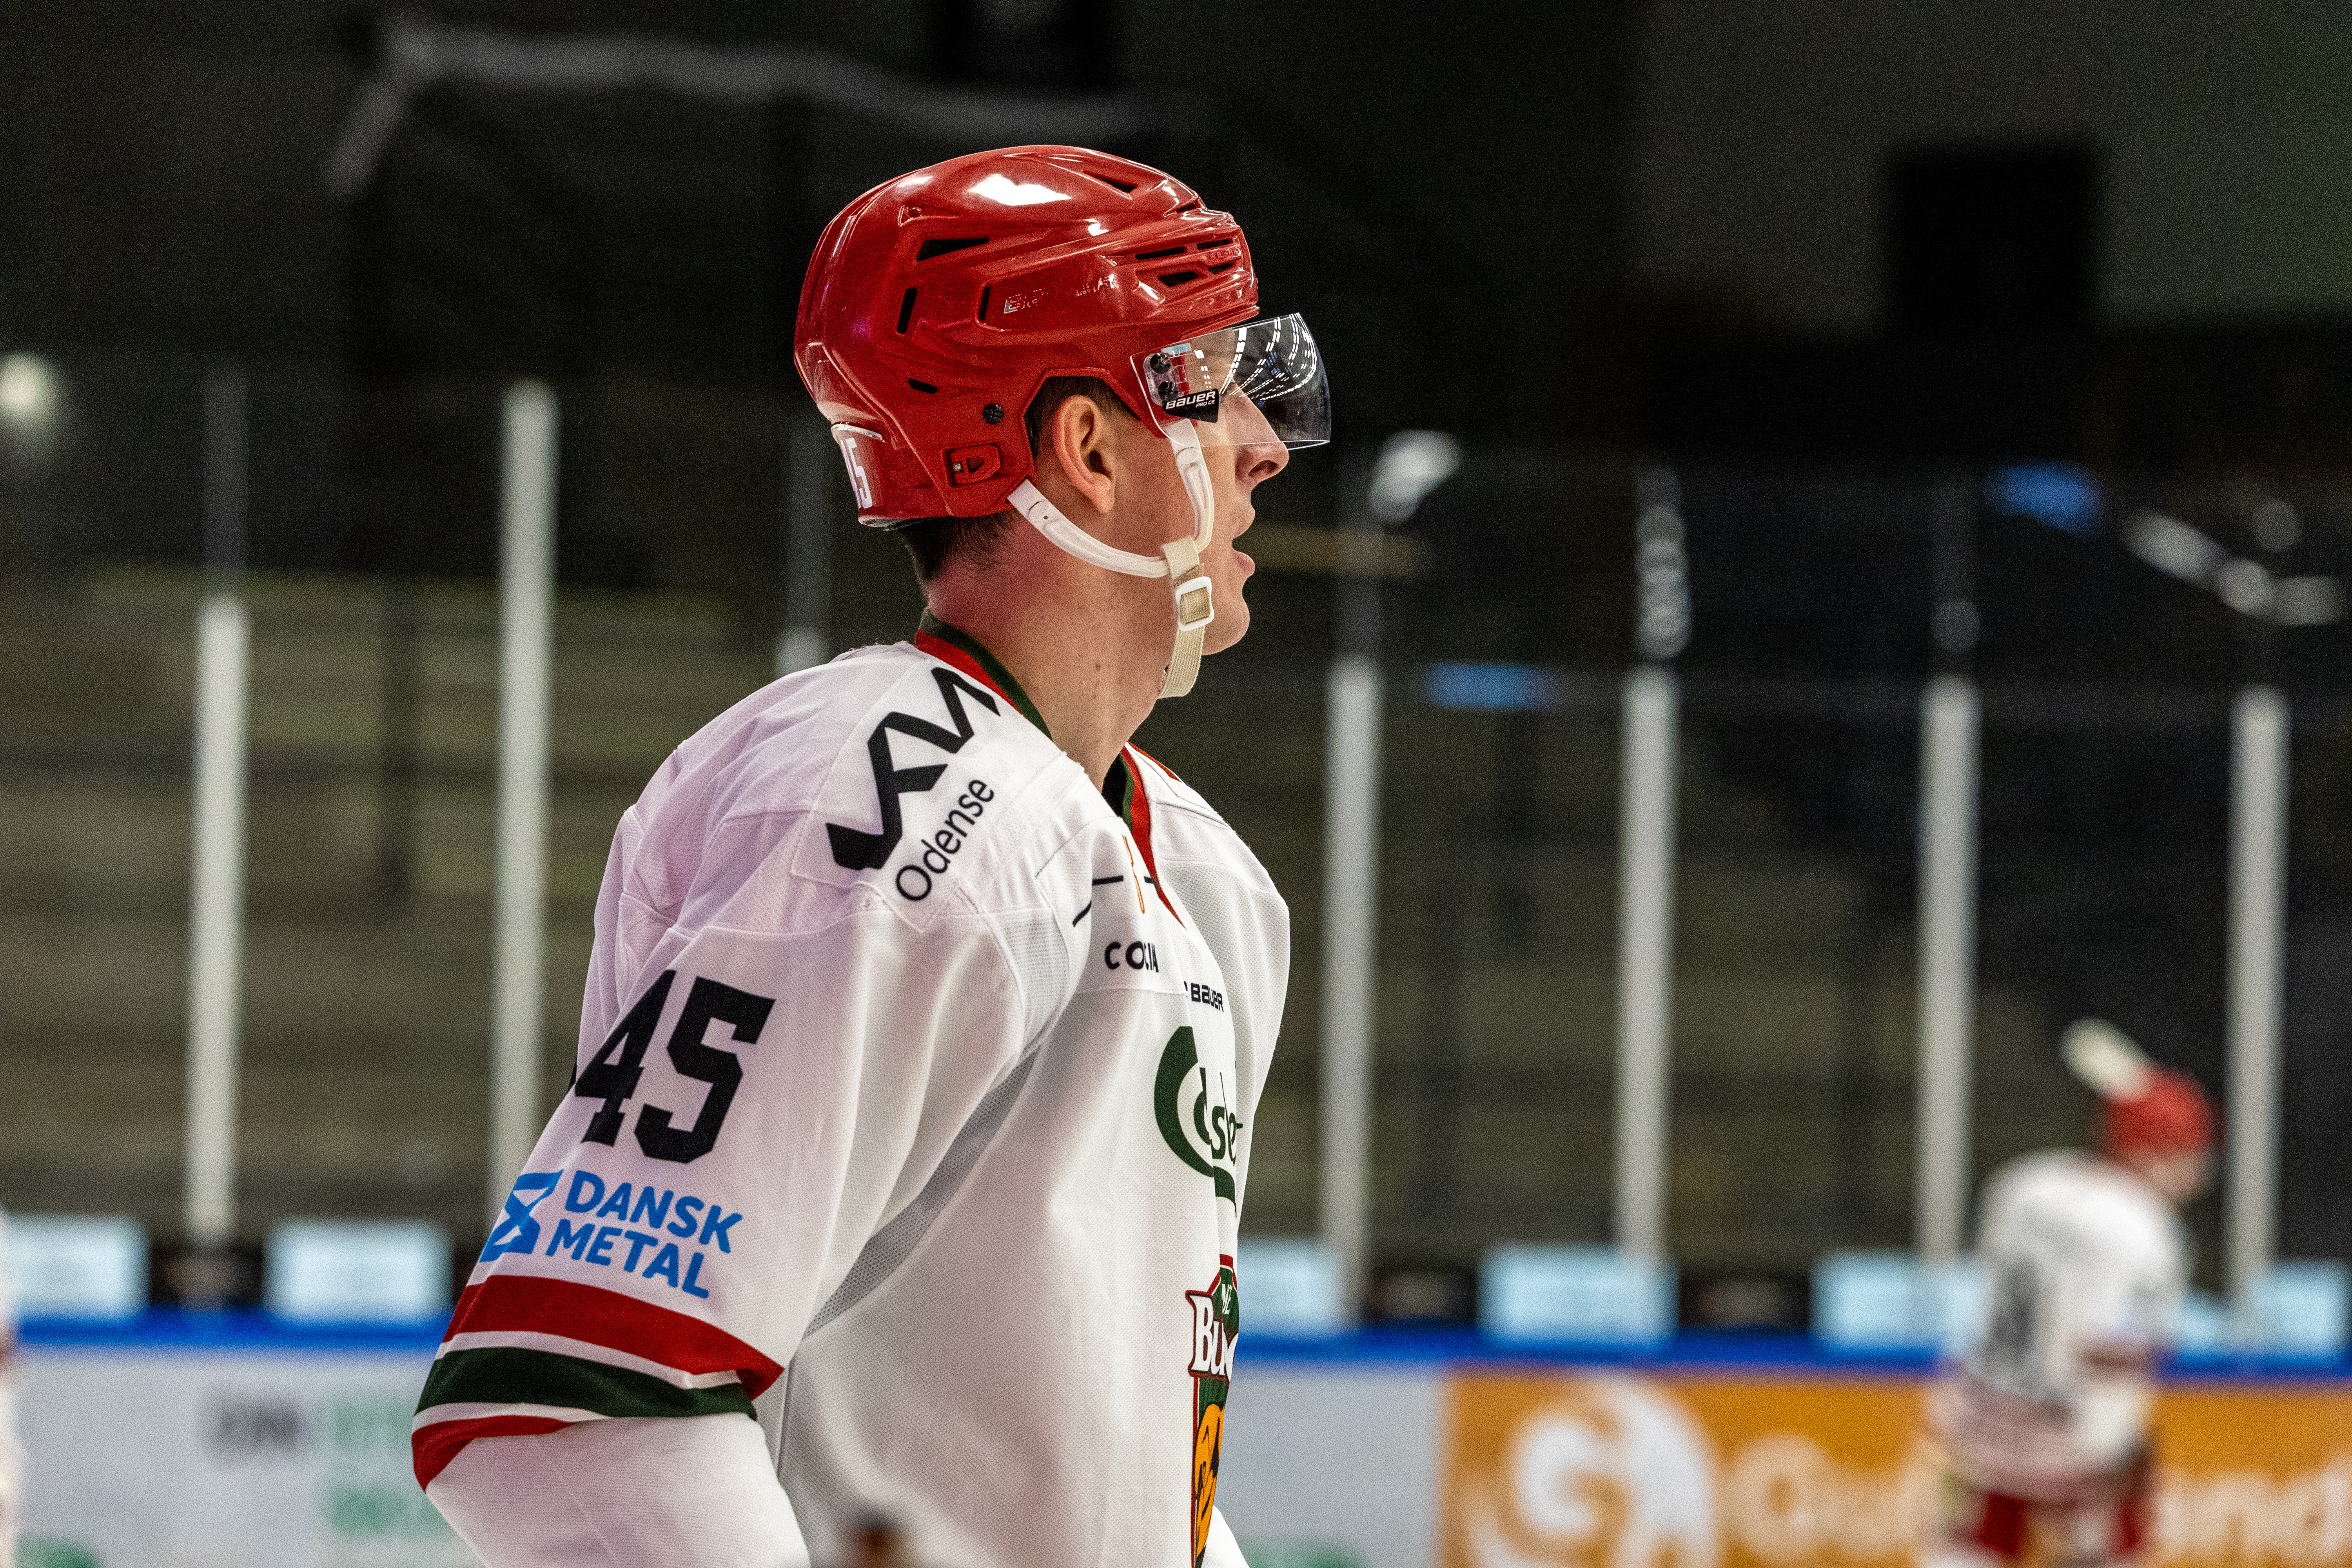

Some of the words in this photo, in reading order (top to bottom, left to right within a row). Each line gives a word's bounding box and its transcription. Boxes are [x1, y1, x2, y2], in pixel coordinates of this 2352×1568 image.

[1166, 391, 1216, 410] BAUER
[840, 437, 873, 509] 5
[896, 779, 995, 901] Odense
[569, 969, 776, 1164] 45
[565, 1169, 743, 1254] DANSK
[546, 1218, 710, 1299] METAL
